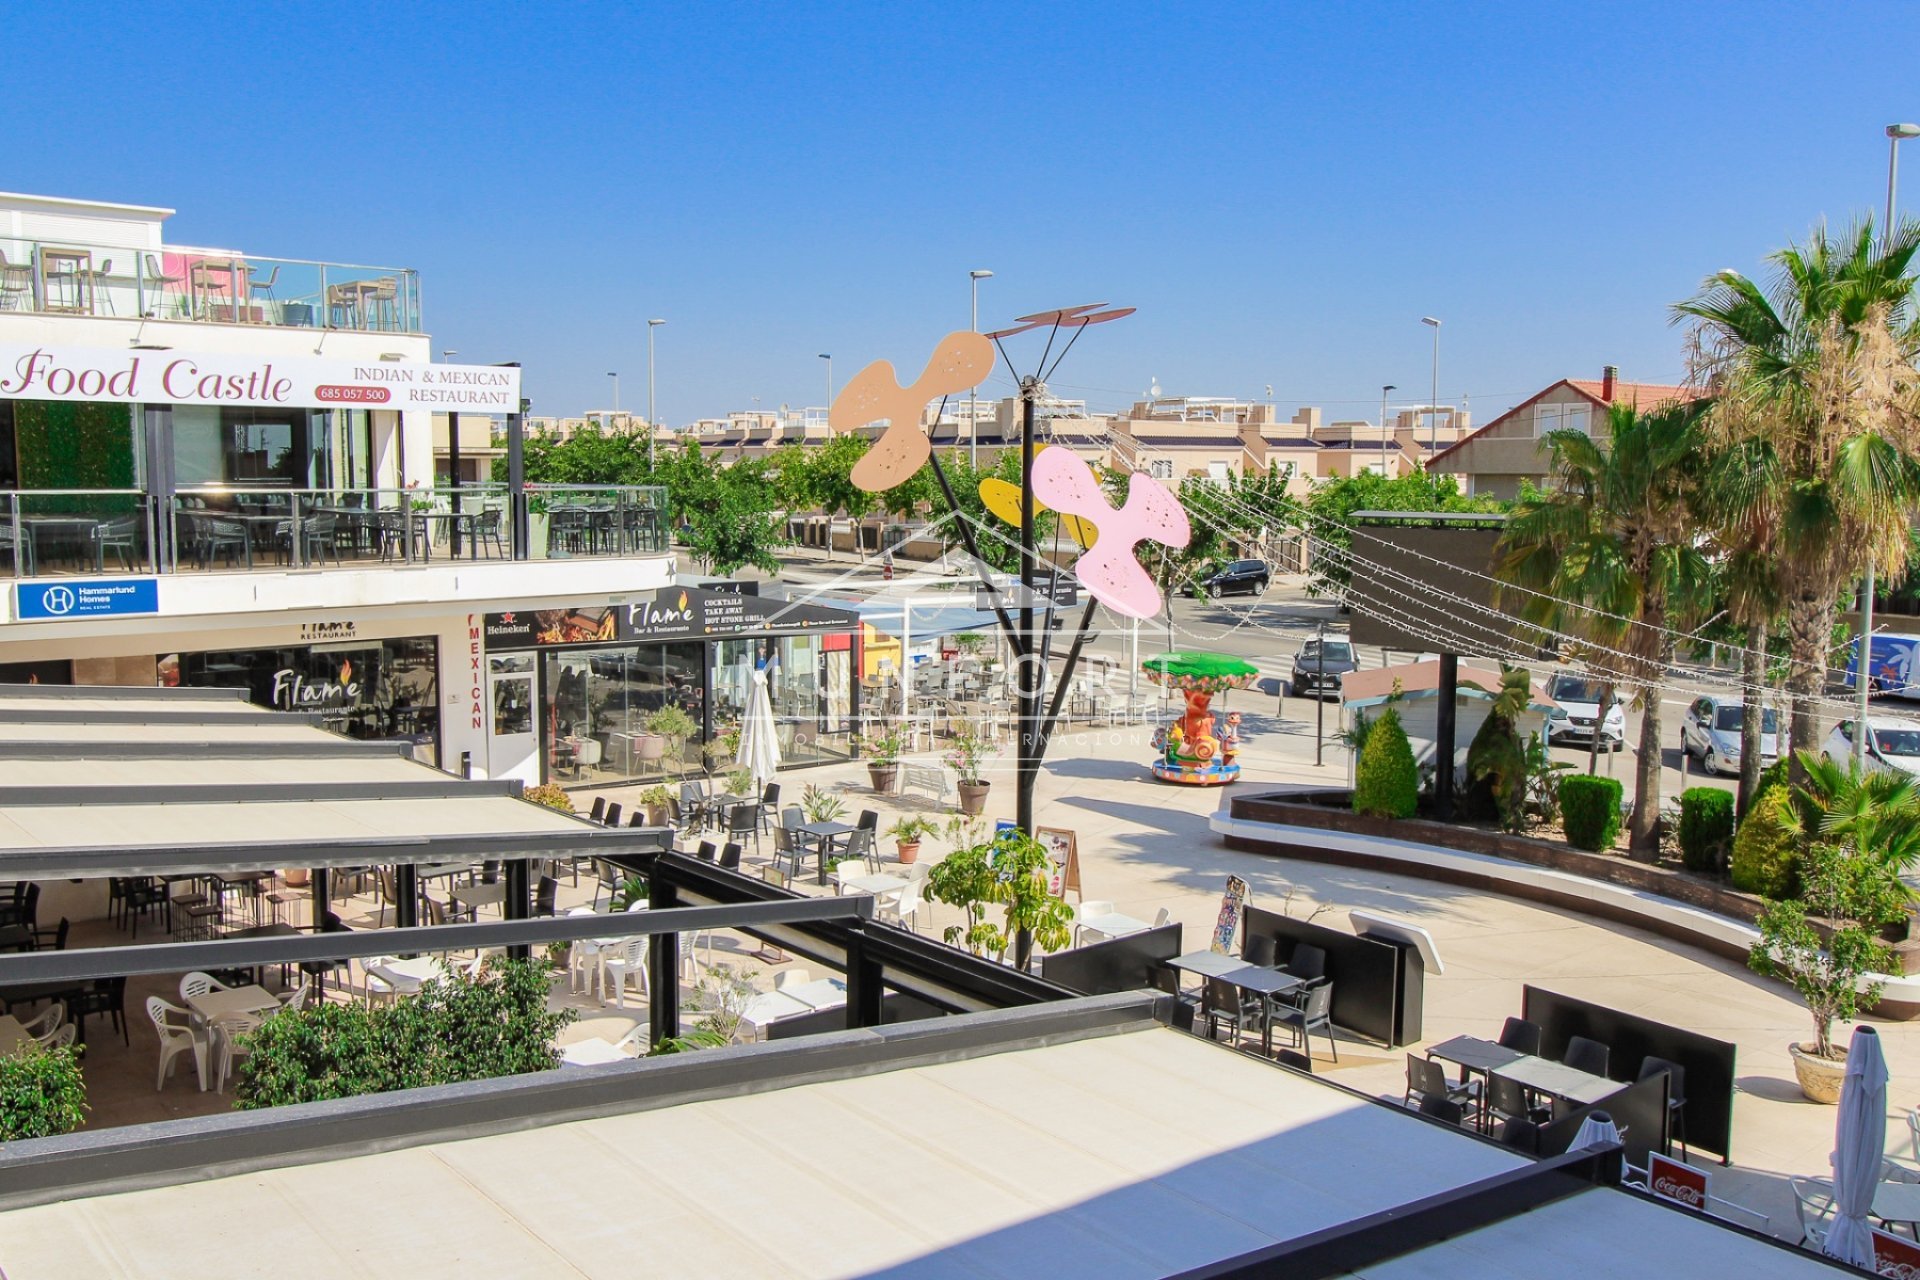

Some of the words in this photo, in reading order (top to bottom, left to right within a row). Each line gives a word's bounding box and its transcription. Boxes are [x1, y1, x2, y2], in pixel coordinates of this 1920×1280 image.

[1, 348, 140, 397] Food
[162, 359, 292, 402] Castle
[354, 367, 413, 382] INDIAN
[422, 371, 435, 383] &
[439, 371, 510, 386] MEXICAN
[321, 388, 340, 399] 685
[343, 388, 363, 399] 057
[366, 389, 385, 400] 500
[409, 388, 510, 404] RESTAURANT
[79, 586, 135, 595] Hammarlund
[704, 598, 743, 607] COCKTAILS
[704, 617, 720, 625] HOT
[720, 616, 744, 624] STONE
[745, 614, 765, 622] GRILL
[487, 624, 530, 635] Heineken
[654, 625, 690, 634] Restaurante
[300, 631, 356, 640] RESTAURANT
[469, 627, 481, 729] MEXICAN
[273, 669, 361, 705] Flame
